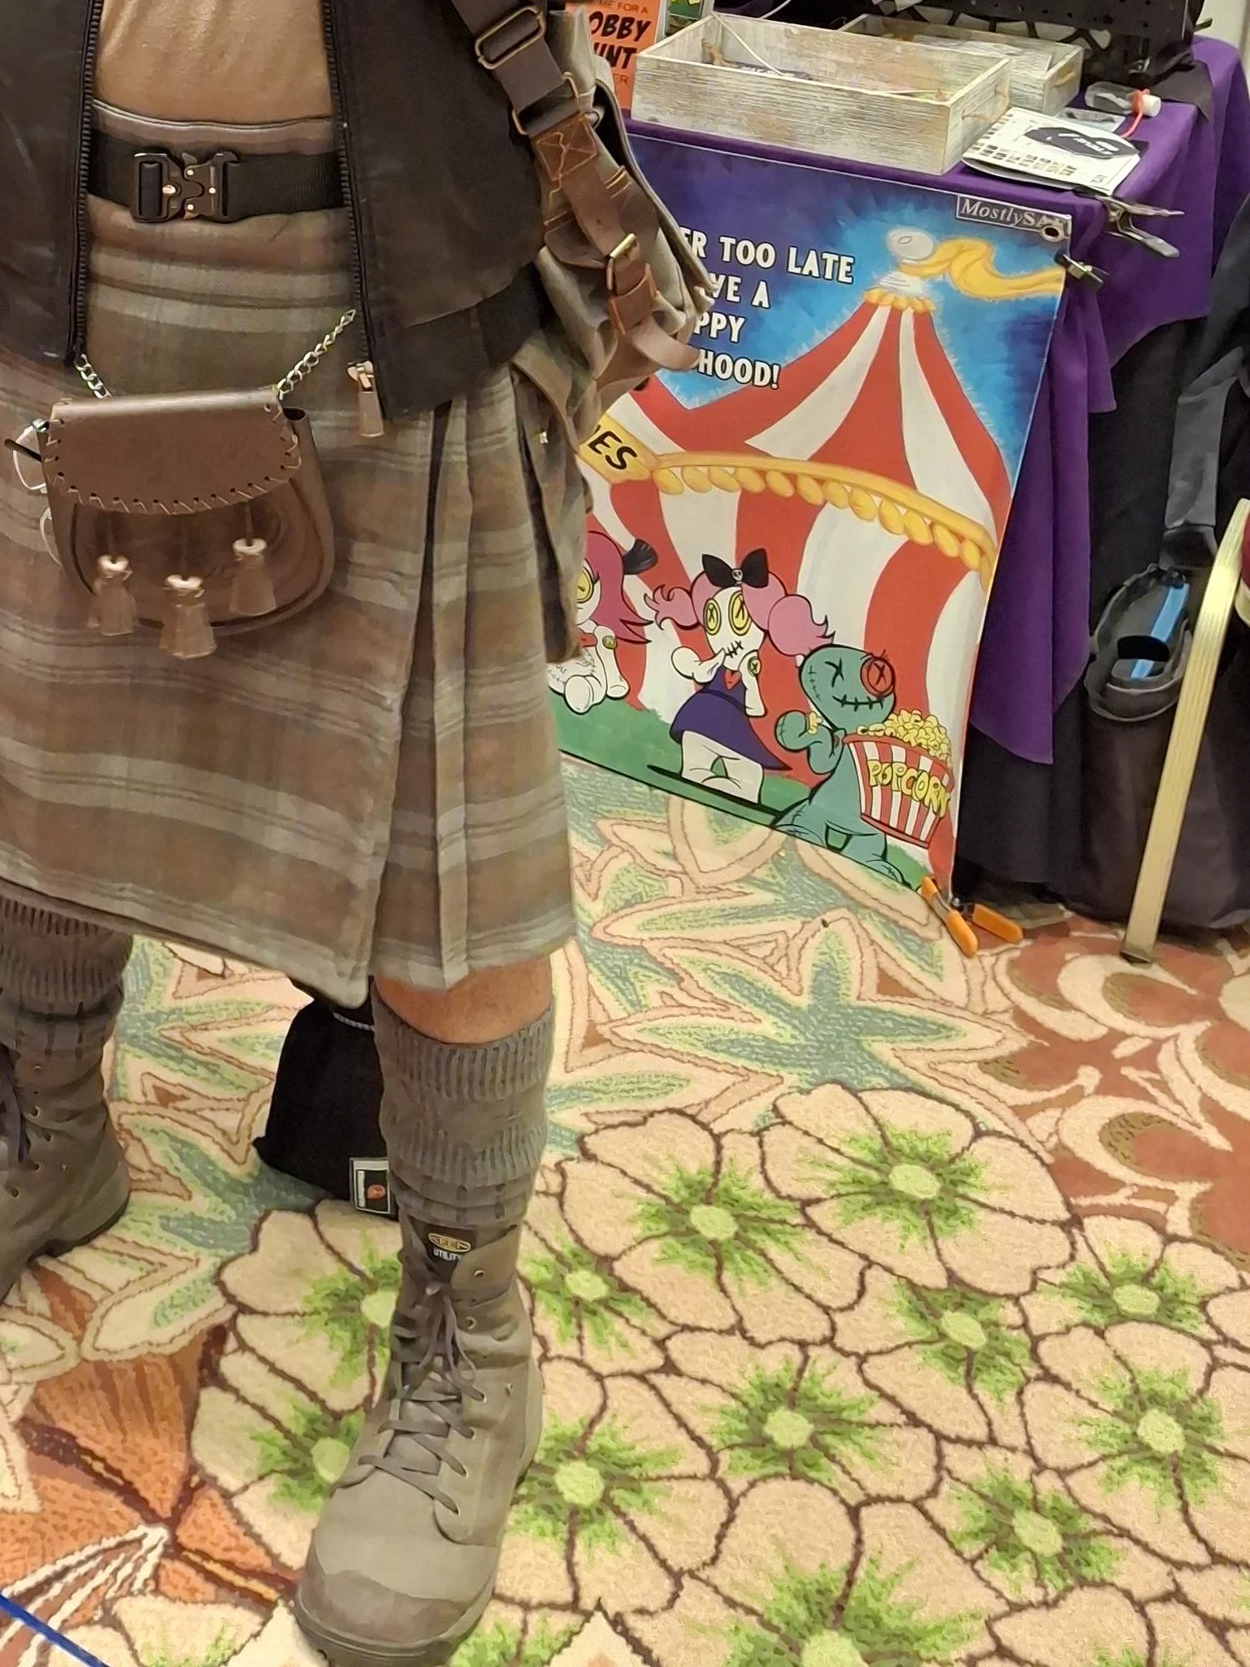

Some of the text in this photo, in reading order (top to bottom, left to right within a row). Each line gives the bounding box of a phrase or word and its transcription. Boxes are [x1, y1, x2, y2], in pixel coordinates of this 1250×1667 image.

[617, 2, 639, 13] FOR
[640, 6, 648, 14] A
[589, 11, 651, 42] OBBY
[593, 42, 637, 69] UNT
[960, 198, 1064, 230] MostlySA
[679, 227, 855, 283] ER TOO LATE
[711, 273, 770, 309] VE A
[694, 312, 745, 343] PPY
[697, 349, 780, 389] HOOD!
[588, 430, 638, 471] ES
[867, 759, 948, 818] POPCORN
